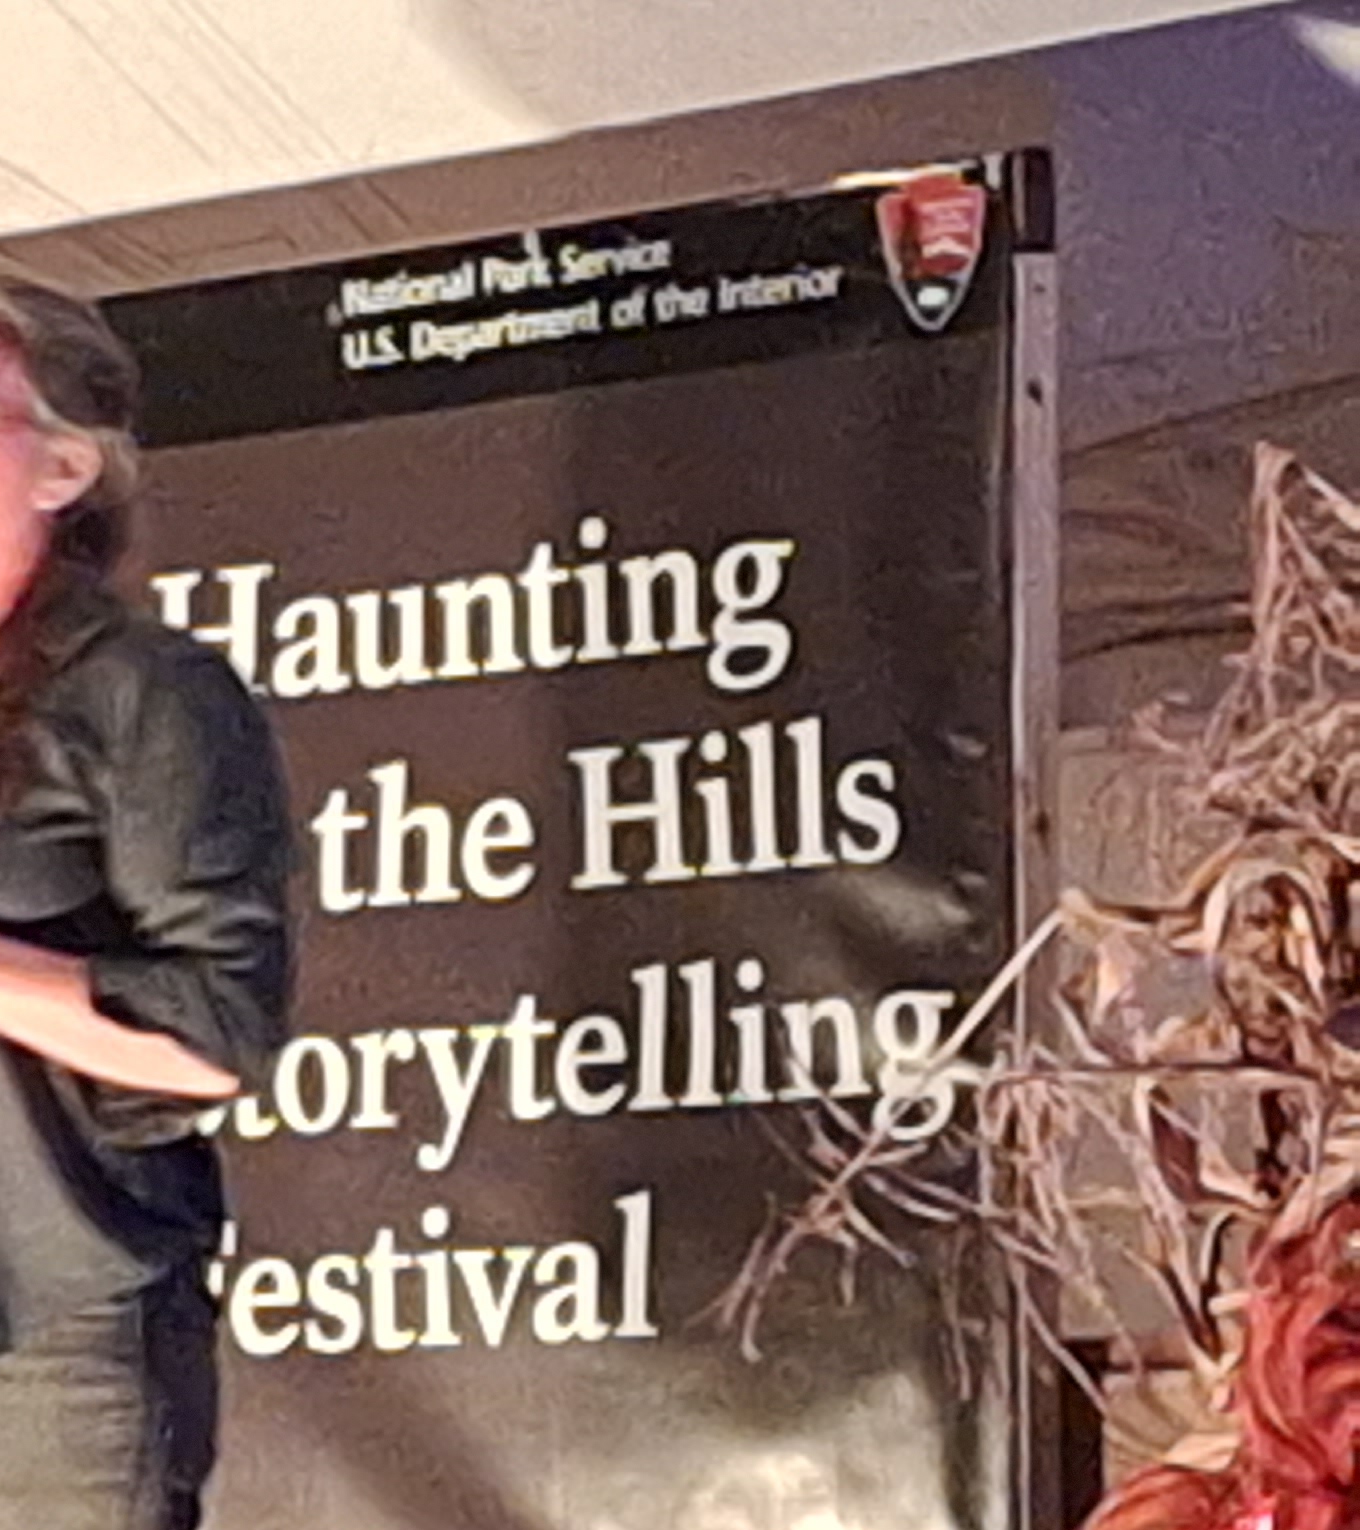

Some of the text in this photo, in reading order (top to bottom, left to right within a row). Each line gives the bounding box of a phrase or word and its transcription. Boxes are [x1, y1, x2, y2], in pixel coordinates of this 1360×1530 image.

[341, 236, 672, 318] National Park Service
[409, 298, 602, 363] Department
[610, 285, 648, 329] of
[653, 283, 711, 323] the
[717, 263, 845, 313] Interior
[152, 517, 795, 698] Haunting
[311, 717, 902, 912] the Hills
[207, 1190, 659, 1356] estival
